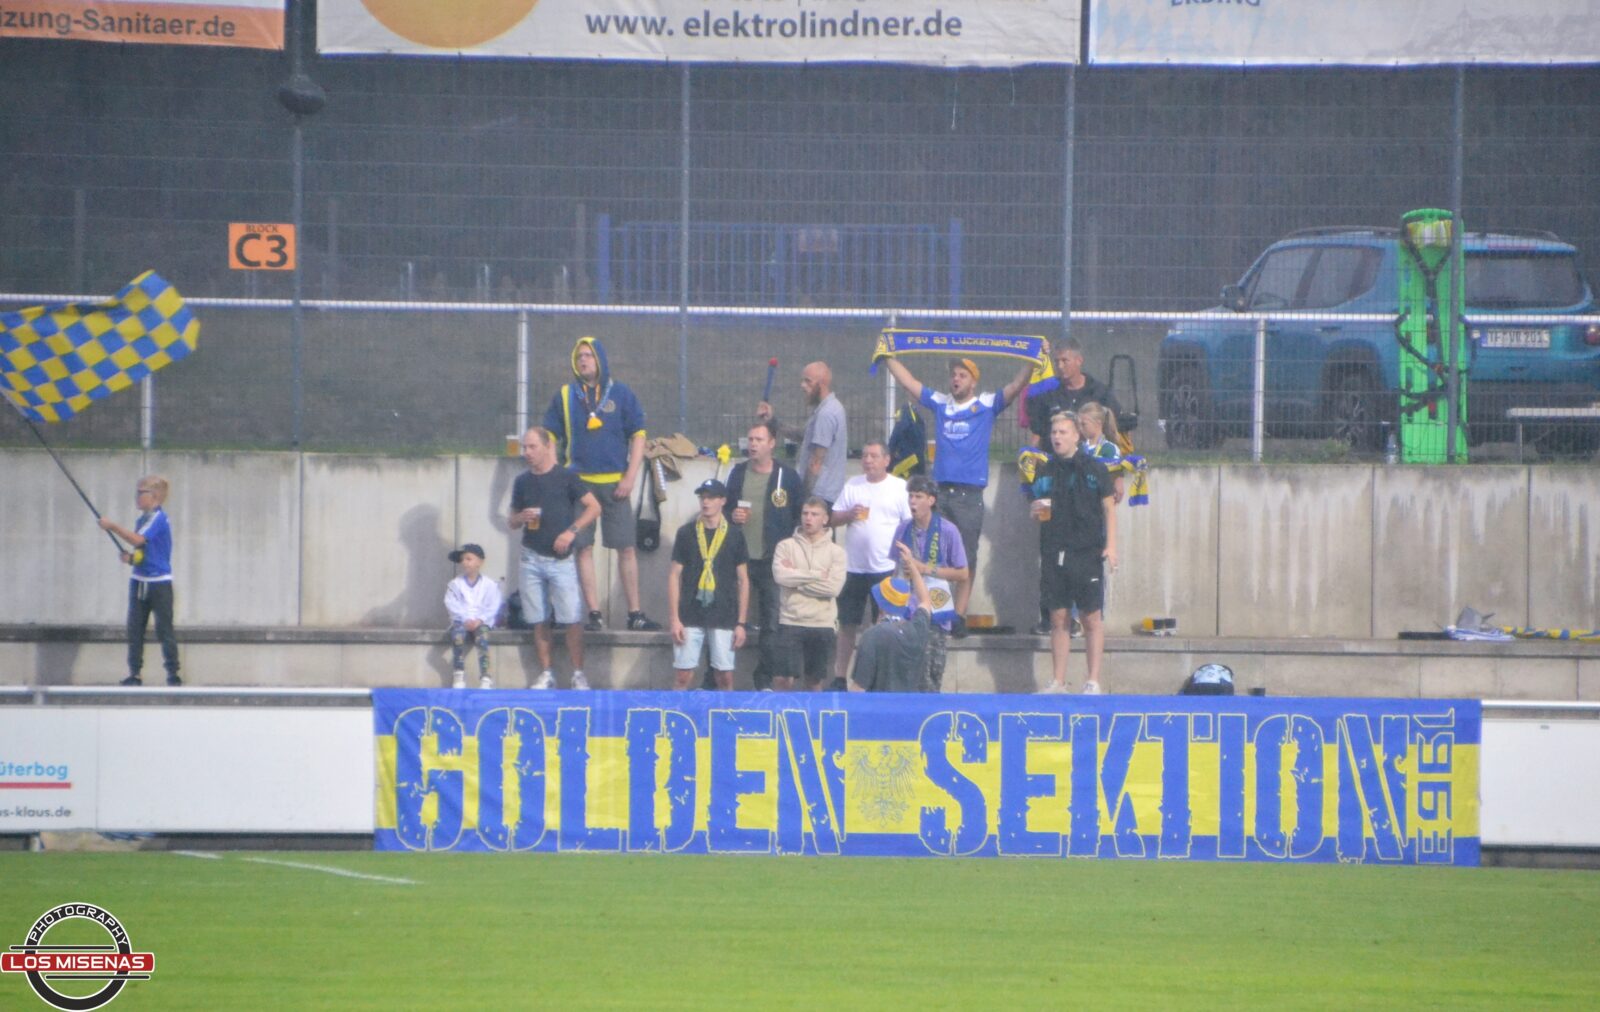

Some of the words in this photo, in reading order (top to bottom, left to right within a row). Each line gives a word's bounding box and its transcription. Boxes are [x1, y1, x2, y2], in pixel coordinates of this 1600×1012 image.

[245, 224, 279, 233] BLOCK
[235, 232, 288, 268] C3
[907, 336, 929, 345] FSV
[393, 706, 848, 856] GOLDEN
[917, 711, 1410, 864] SEKTION
[1413, 707, 1455, 865] 1963
